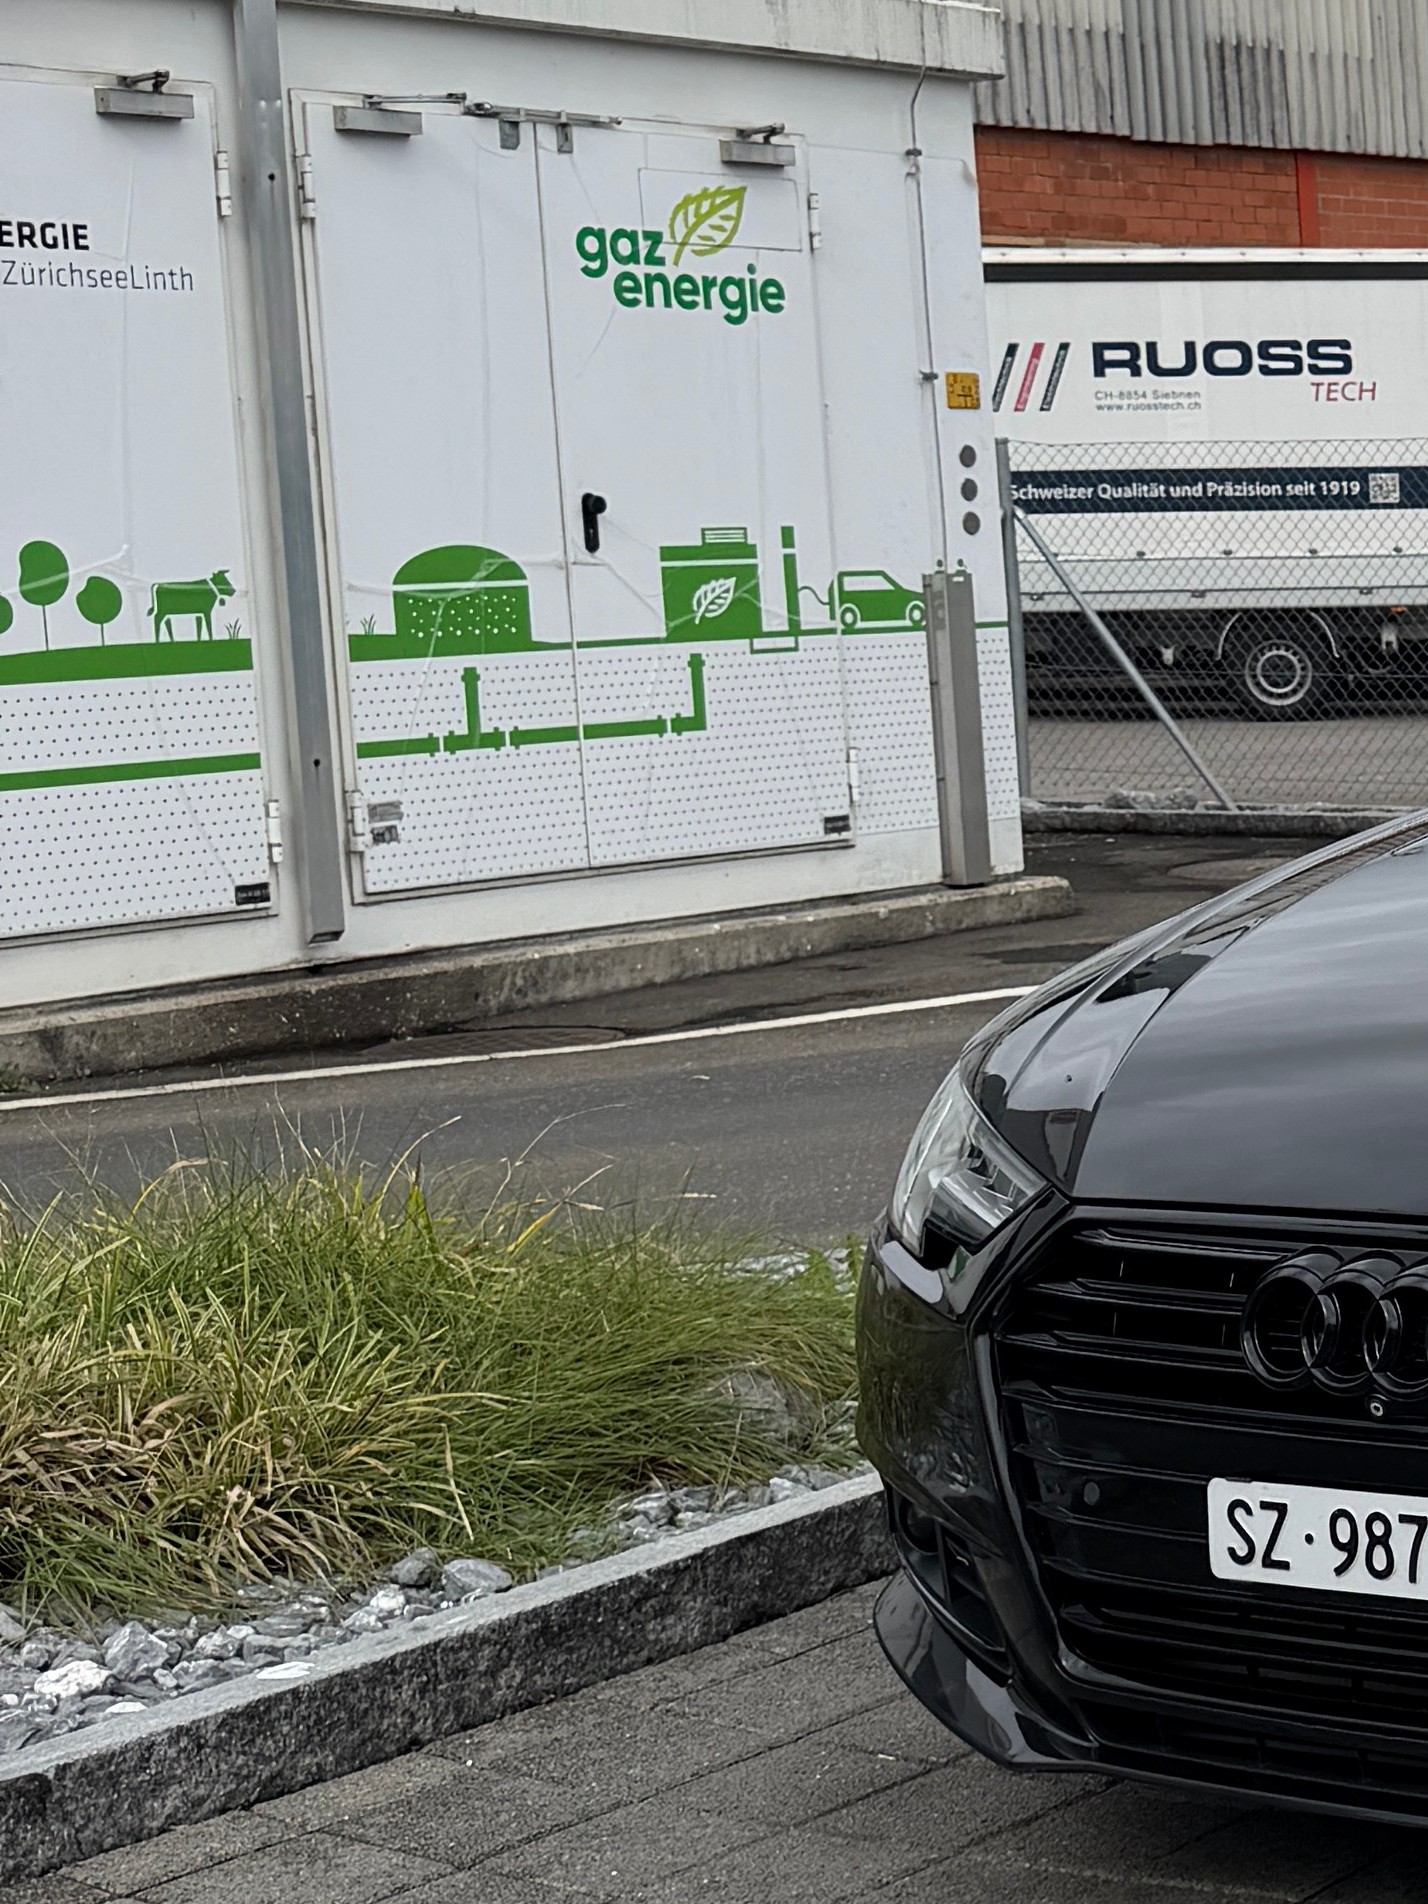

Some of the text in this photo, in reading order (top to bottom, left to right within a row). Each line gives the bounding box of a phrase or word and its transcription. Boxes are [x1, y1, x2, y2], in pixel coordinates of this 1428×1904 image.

[575, 226, 666, 278] gaz
[1, 259, 194, 291] ZürichseeLinth
[613, 263, 786, 325] energie
[1091, 338, 1353, 378] RUOSS
[1310, 381, 1377, 402] TECH
[1009, 480, 1361, 501] Schweizer Qualität und Präzision seit 1919
